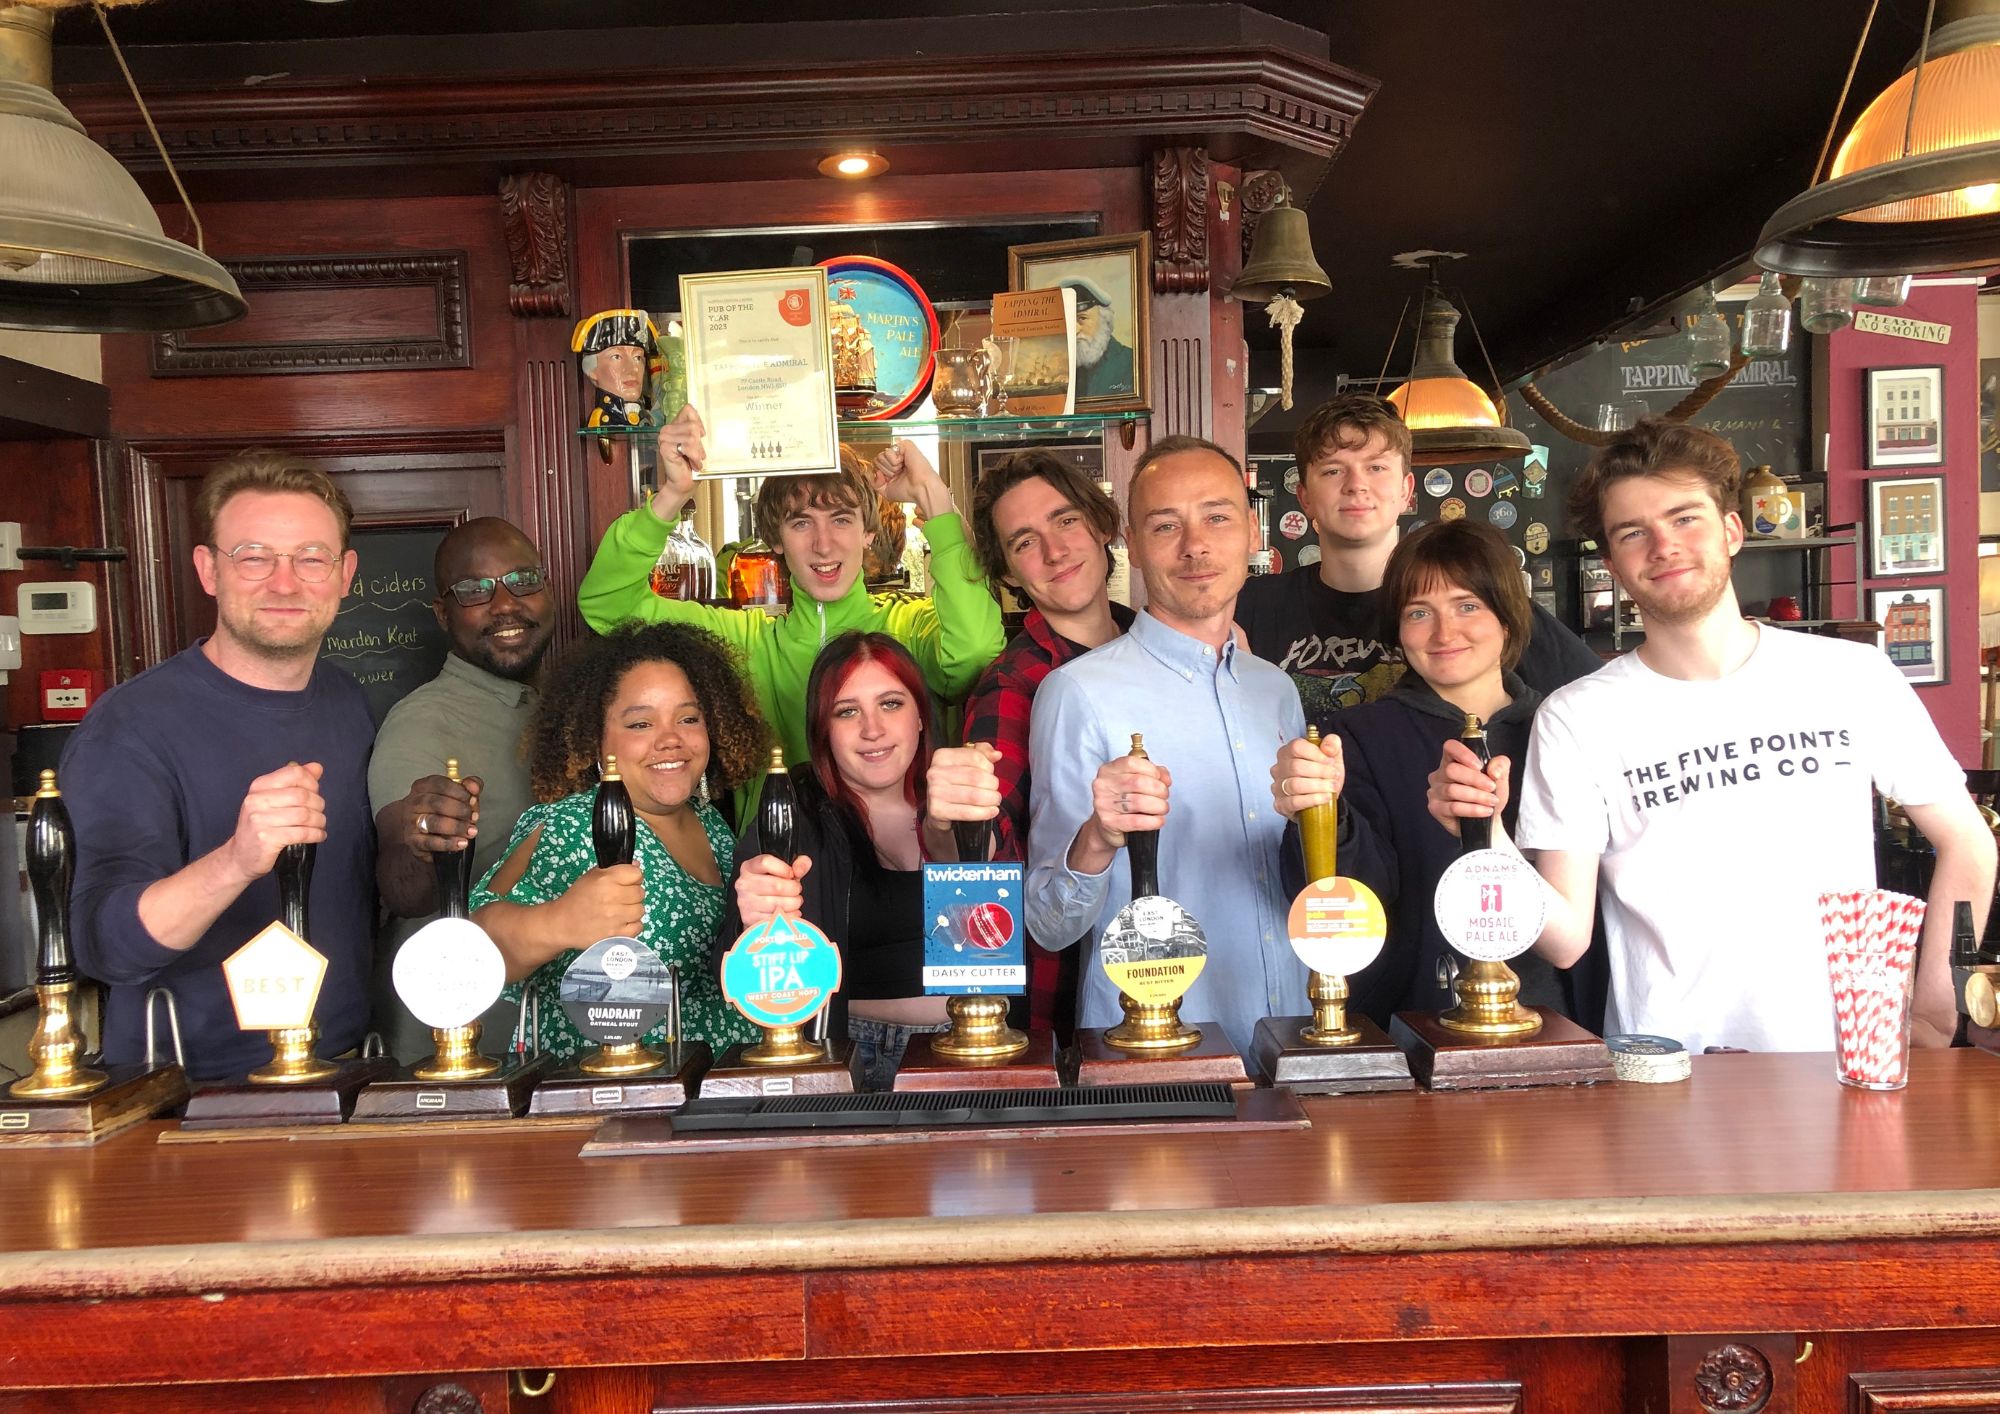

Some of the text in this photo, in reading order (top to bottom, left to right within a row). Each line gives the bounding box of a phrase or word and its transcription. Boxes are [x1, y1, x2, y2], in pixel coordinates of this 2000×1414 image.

[708, 303, 754, 313] PUB OF THE
[1003, 295, 1057, 309] TAPPING THE
[708, 314, 729, 322] YAR
[1012, 309, 1050, 319] ADMIRAL
[1865, 314, 1919, 327] PLEASE
[709, 323, 728, 331] 2023
[1860, 319, 1947, 342] NO SMOKING
[886, 329, 917, 342] PALE
[900, 346, 920, 358] ALE
[770, 358, 808, 368] ADMIRAL
[1621, 360, 1797, 388] TAPPING MIRAL
[746, 402, 784, 411] Winner
[370, 570, 426, 594] Ciders
[388, 624, 418, 644] Kent
[1623, 730, 1850, 788] THE FIVE POINTS
[926, 866, 1021, 882] twickenham
[1465, 864, 1518, 873] ADNAMS
[1469, 916, 1514, 928] MOSAIC
[1466, 930, 1519, 942] PALE ALE
[752, 952, 786, 968] STIFF
[760, 964, 805, 992] IPA
[932, 968, 1016, 977] DAISY CUTTER
[1126, 964, 1185, 979] FOUNDATION
[244, 976, 304, 993] BEST
[770, 991, 796, 999] COAST
[588, 1007, 643, 1021] QUADRANT
